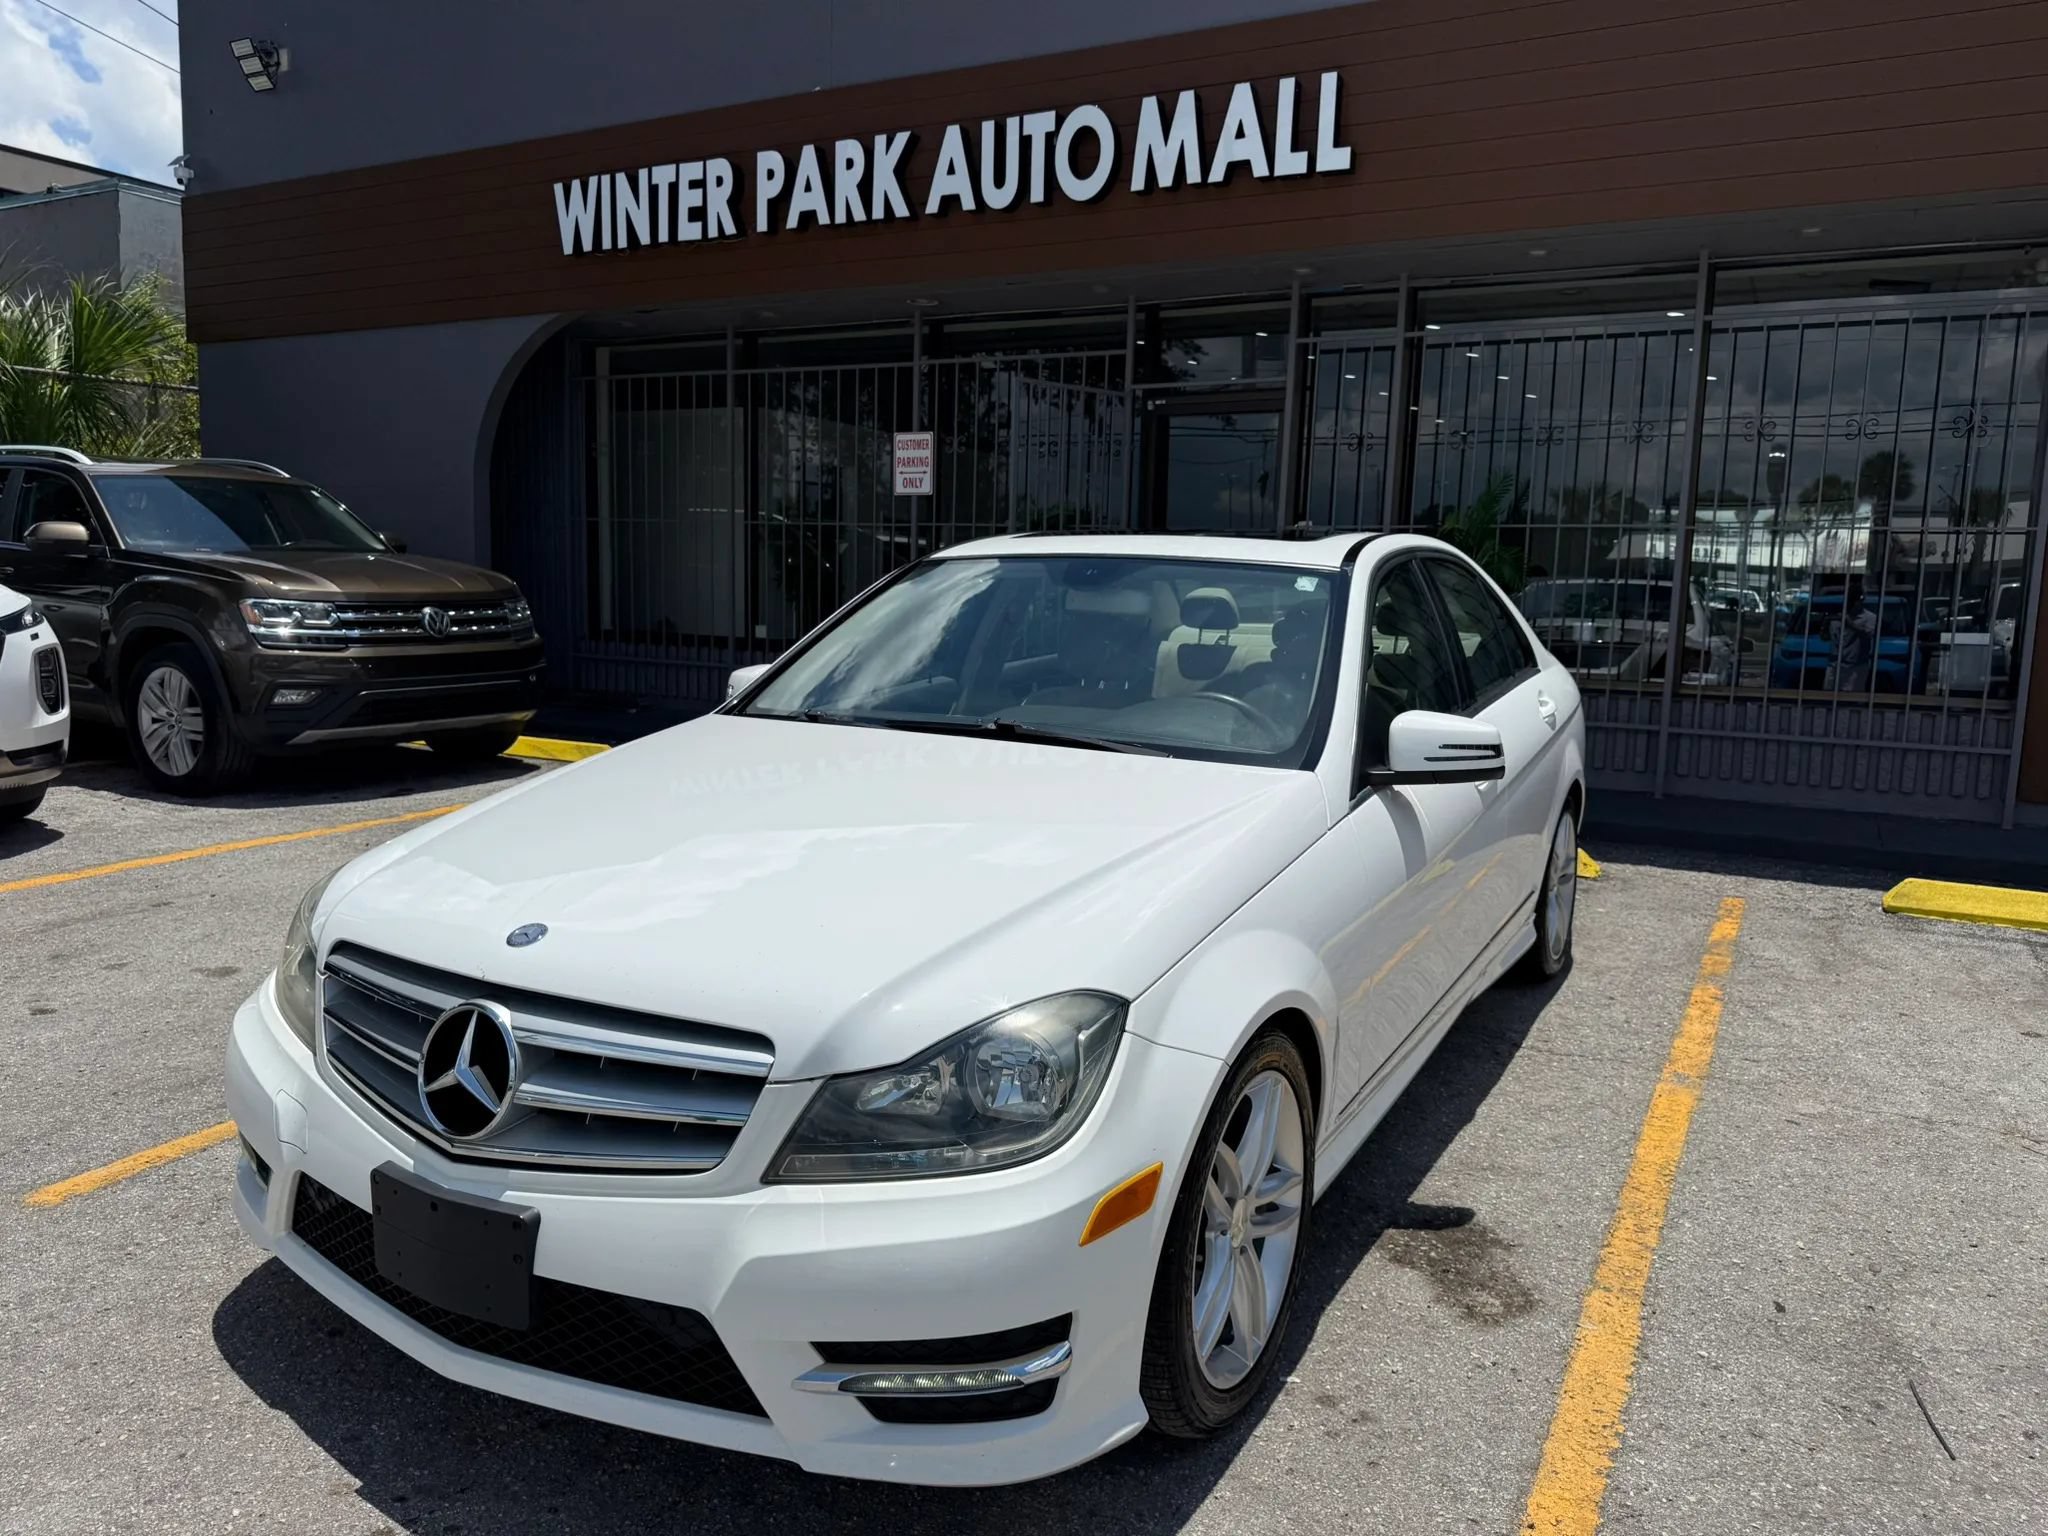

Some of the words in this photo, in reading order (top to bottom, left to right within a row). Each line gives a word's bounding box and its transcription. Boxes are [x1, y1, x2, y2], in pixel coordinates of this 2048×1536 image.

[554, 157, 737, 256] WINTER
[756, 131, 912, 233] PARK
[925, 104, 1116, 215] AUTO
[1130, 71, 1352, 192] MALL
[897, 439, 929, 451] CUSTOMER
[896, 457, 929, 468] PARKING
[902, 477, 924, 489] ONLY
